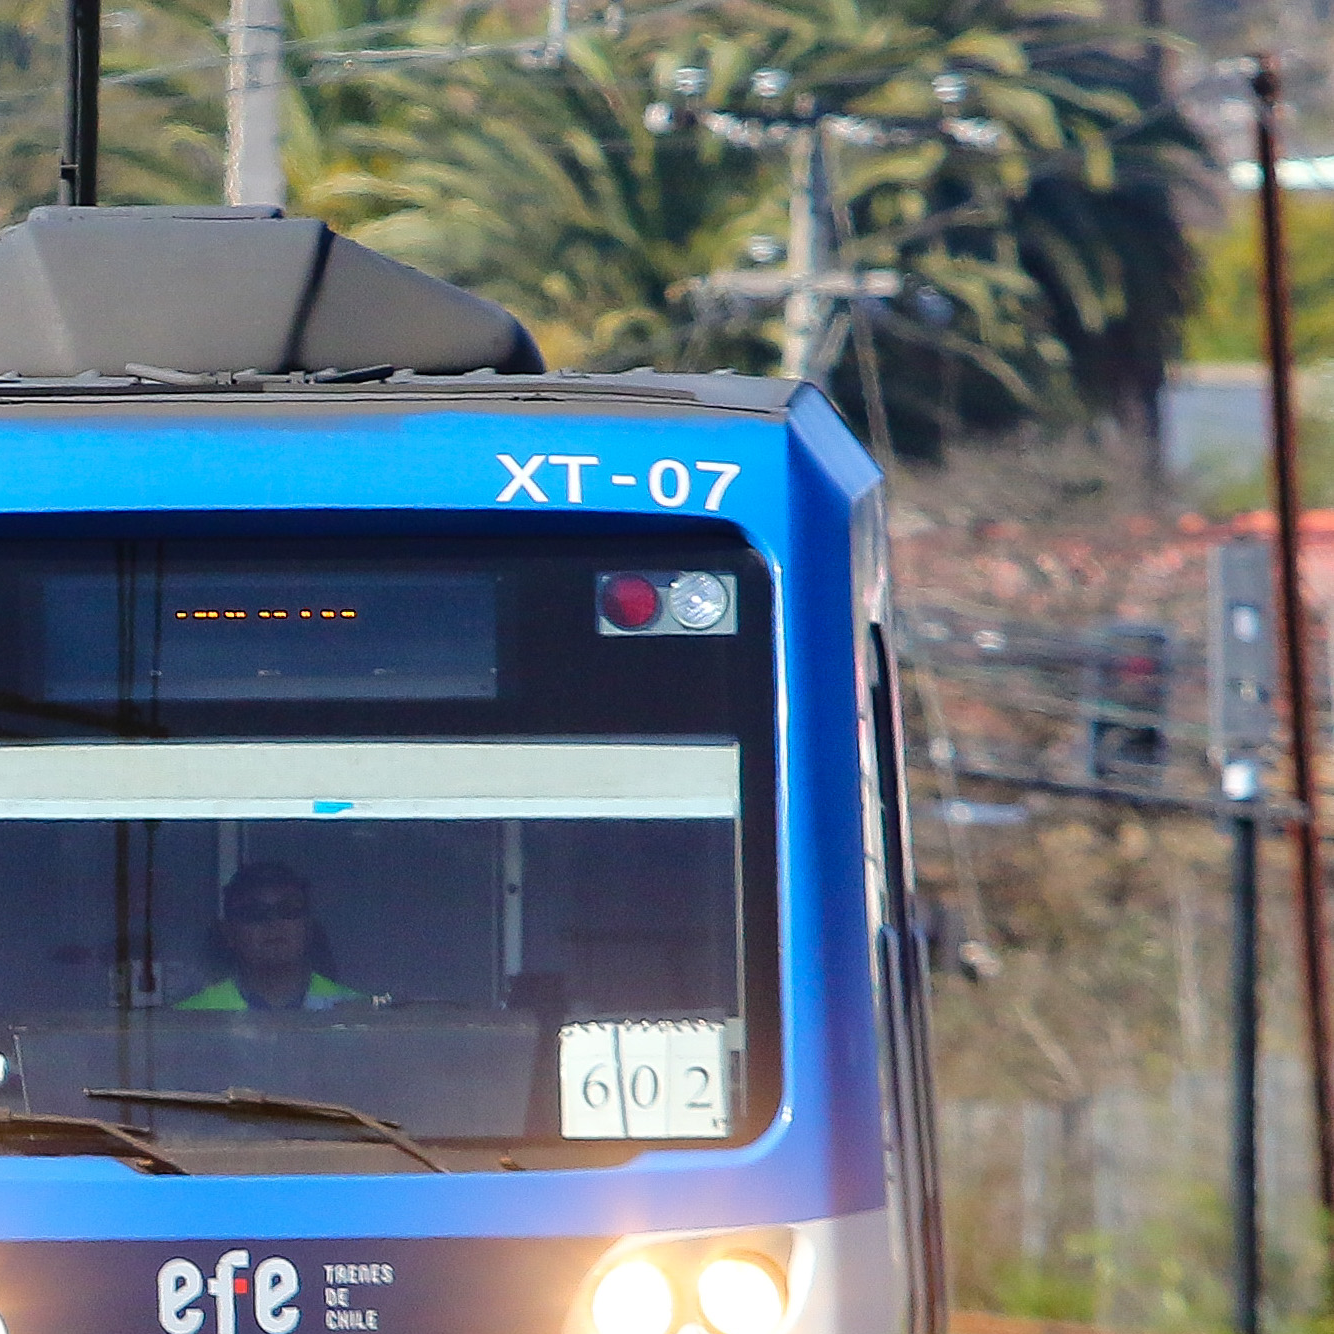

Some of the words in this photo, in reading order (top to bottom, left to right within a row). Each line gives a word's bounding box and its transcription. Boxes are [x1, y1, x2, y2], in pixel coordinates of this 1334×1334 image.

[495, 453, 742, 512] XT-07
[324, 1287, 350, 1308] DE
[324, 1309, 380, 1331] CHILE
